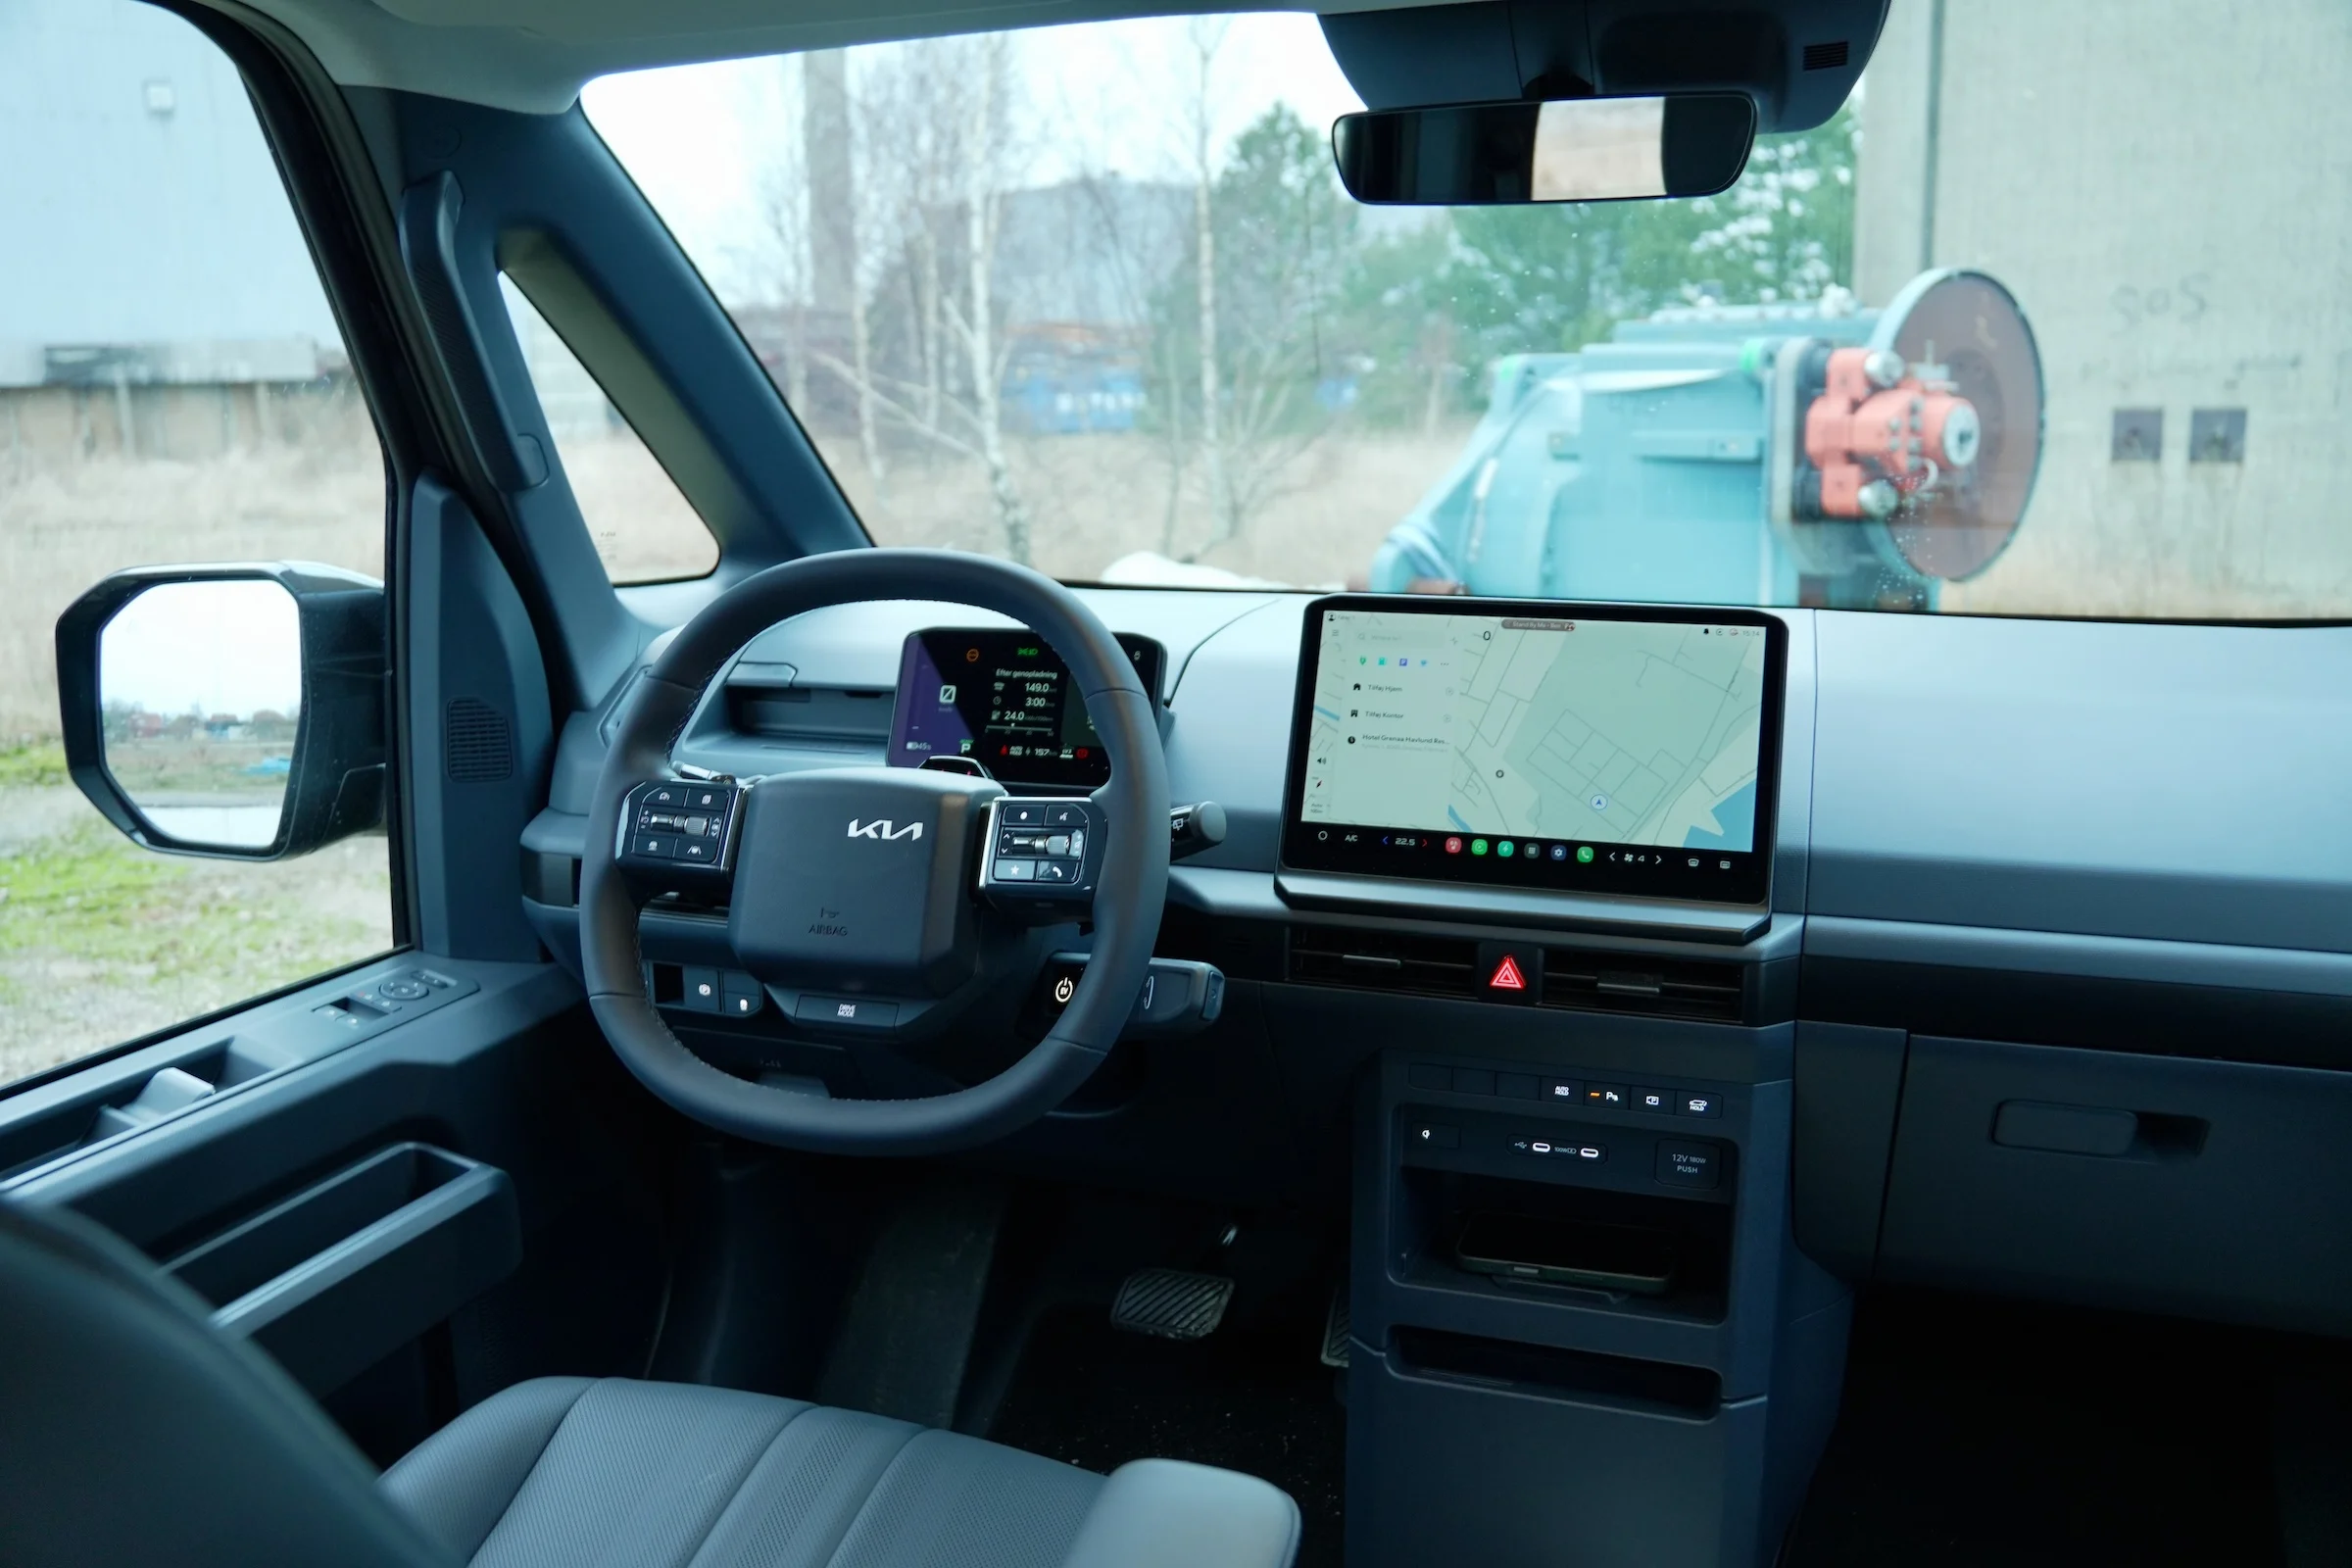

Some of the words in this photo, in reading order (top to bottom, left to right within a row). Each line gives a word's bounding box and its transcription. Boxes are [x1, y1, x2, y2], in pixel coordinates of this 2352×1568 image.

[1012, 670, 1057, 679] genopladning
[1025, 682, 1050, 692] 149.0
[1025, 697, 1046, 707] 3:00
[1004, 710, 1025, 720] 24.0
[961, 743, 971, 754] P
[848, 818, 924, 842] KIA
[808, 924, 848, 937] AIRBAG
[1672, 1153, 1689, 1162] 12V
